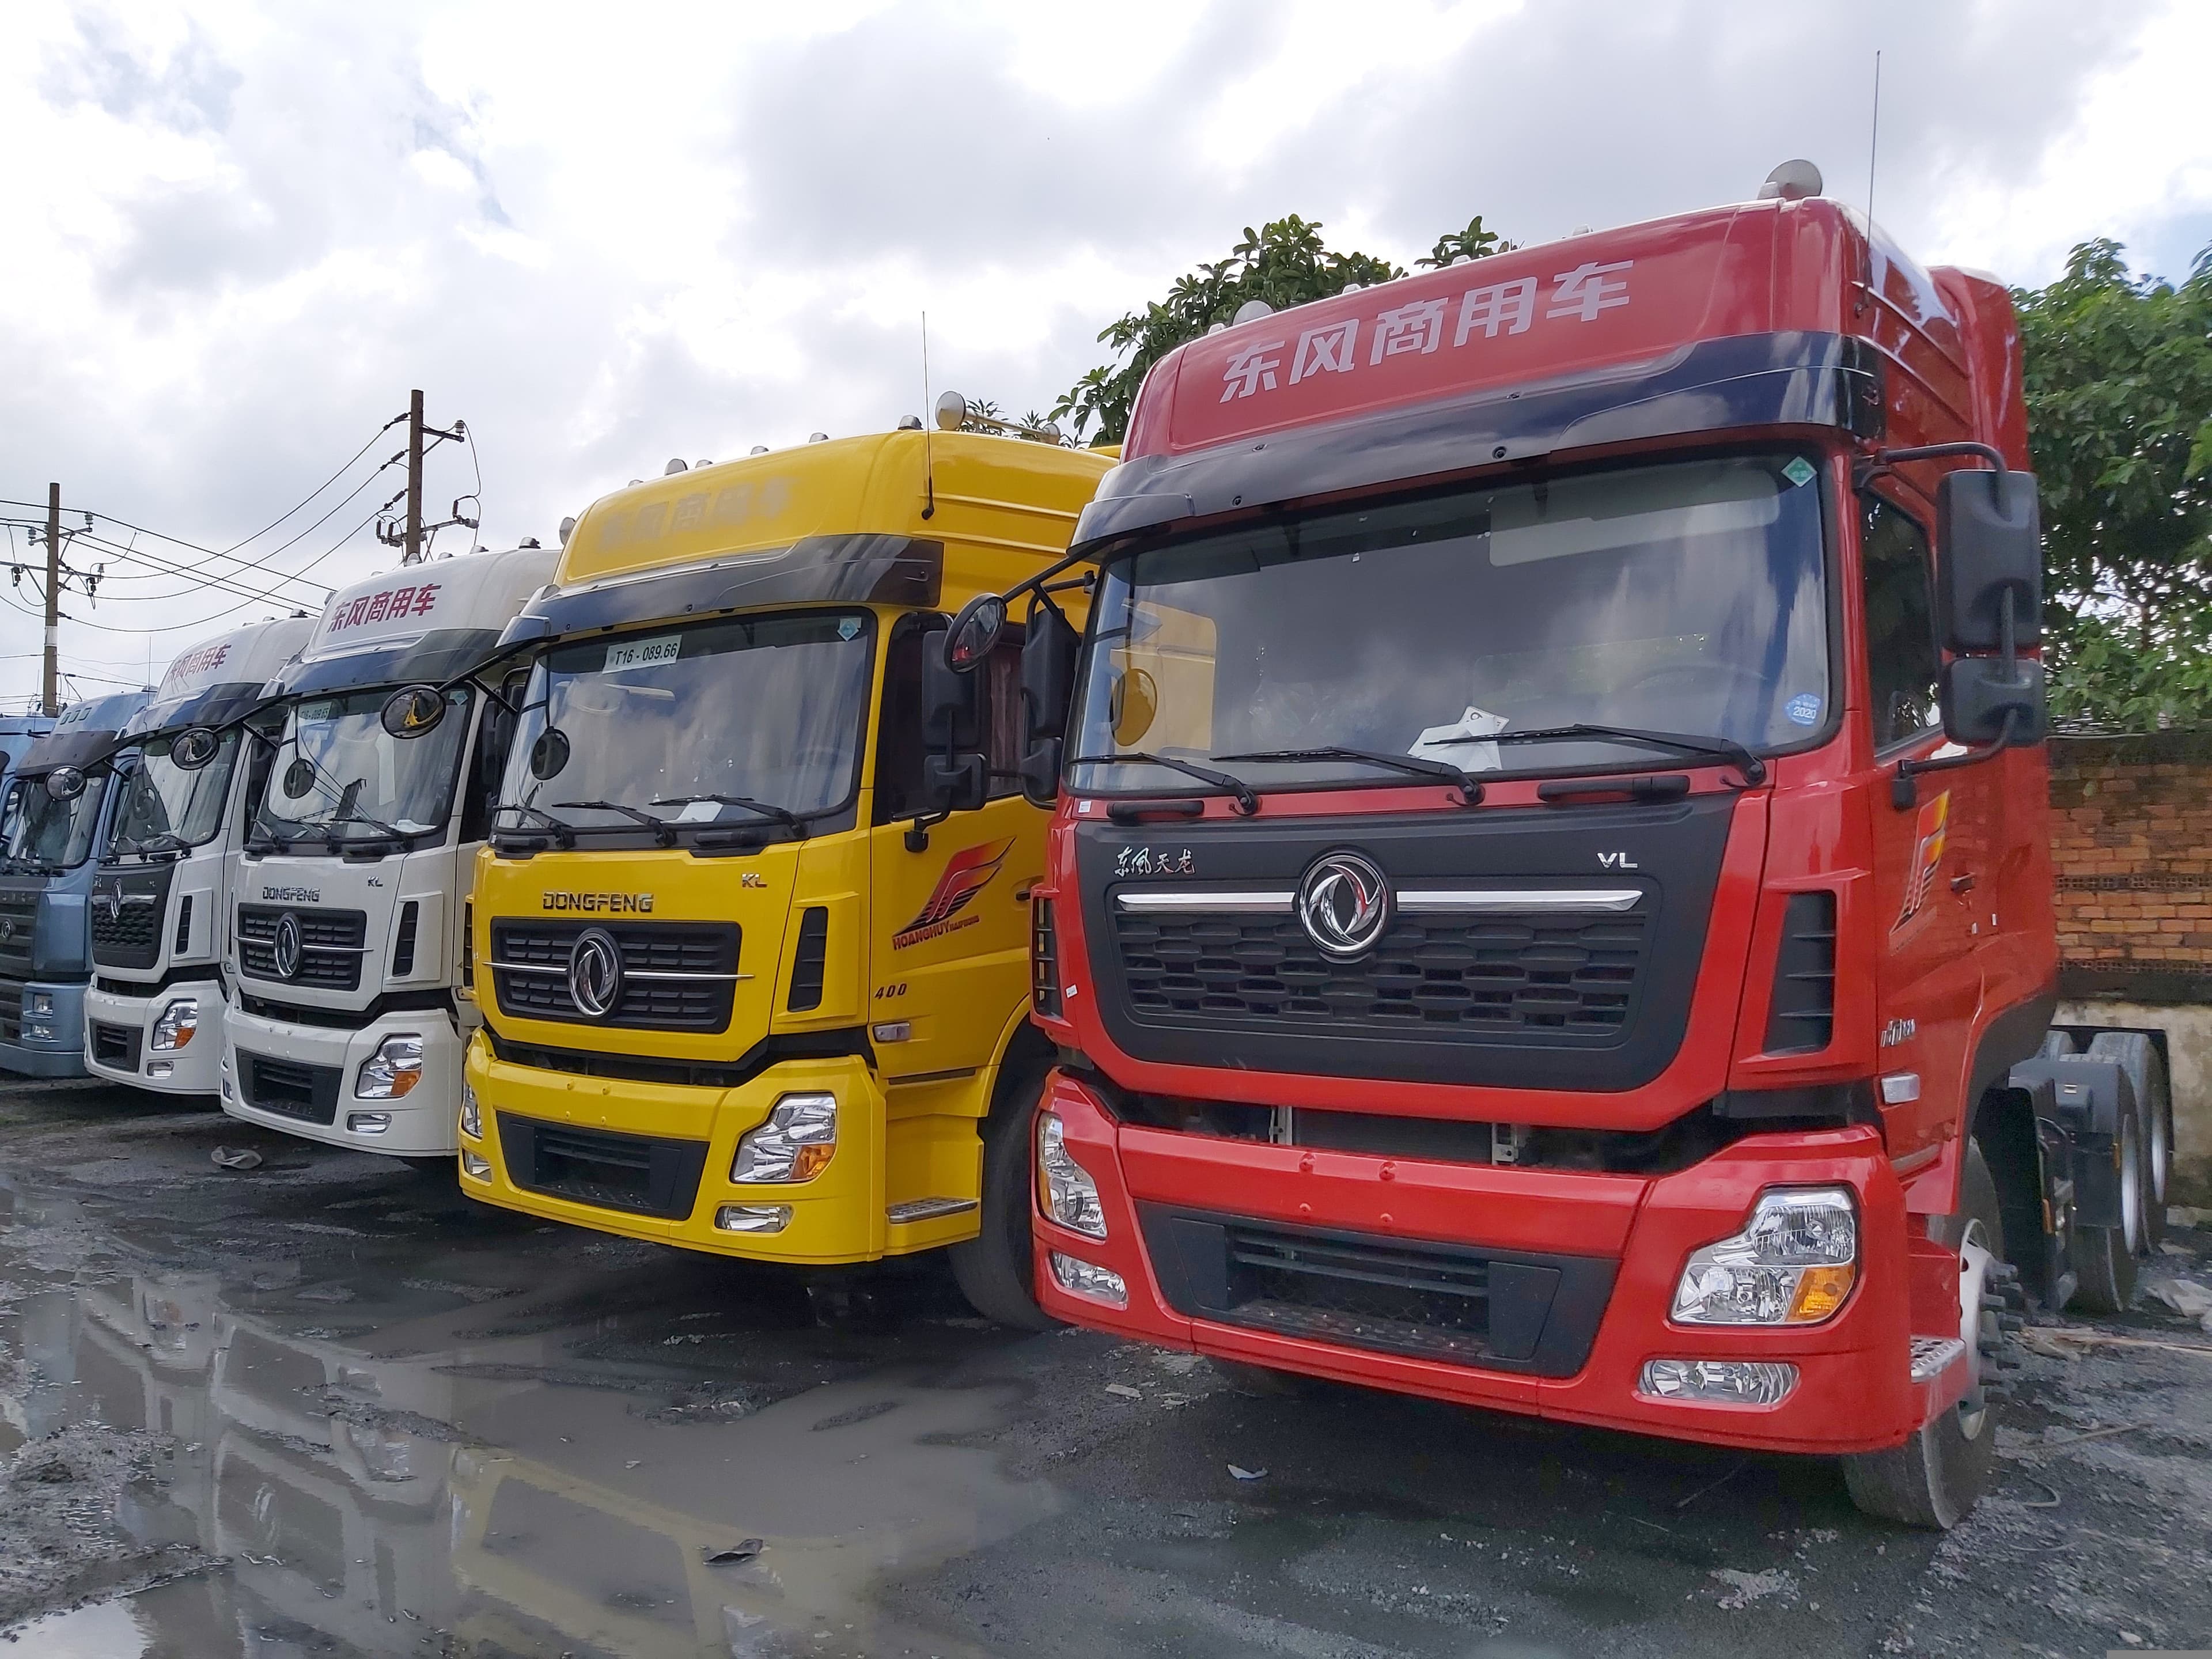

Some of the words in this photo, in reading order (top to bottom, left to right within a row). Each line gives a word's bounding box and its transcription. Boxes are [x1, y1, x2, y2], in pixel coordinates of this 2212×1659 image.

[1219, 260, 1634, 403] 东风商用车
[327, 583, 442, 633] 东风商用车
[616, 649, 634, 665] T16
[642, 643, 678, 661] 089.66
[1793, 706, 1816, 719] 2020
[1597, 853, 1638, 869] VL
[368, 876, 383, 887] KL
[742, 873, 767, 888] KL
[263, 887, 320, 902] DONGFENG
[543, 891, 654, 912] DONGFENG
[874, 983, 907, 999] 400
